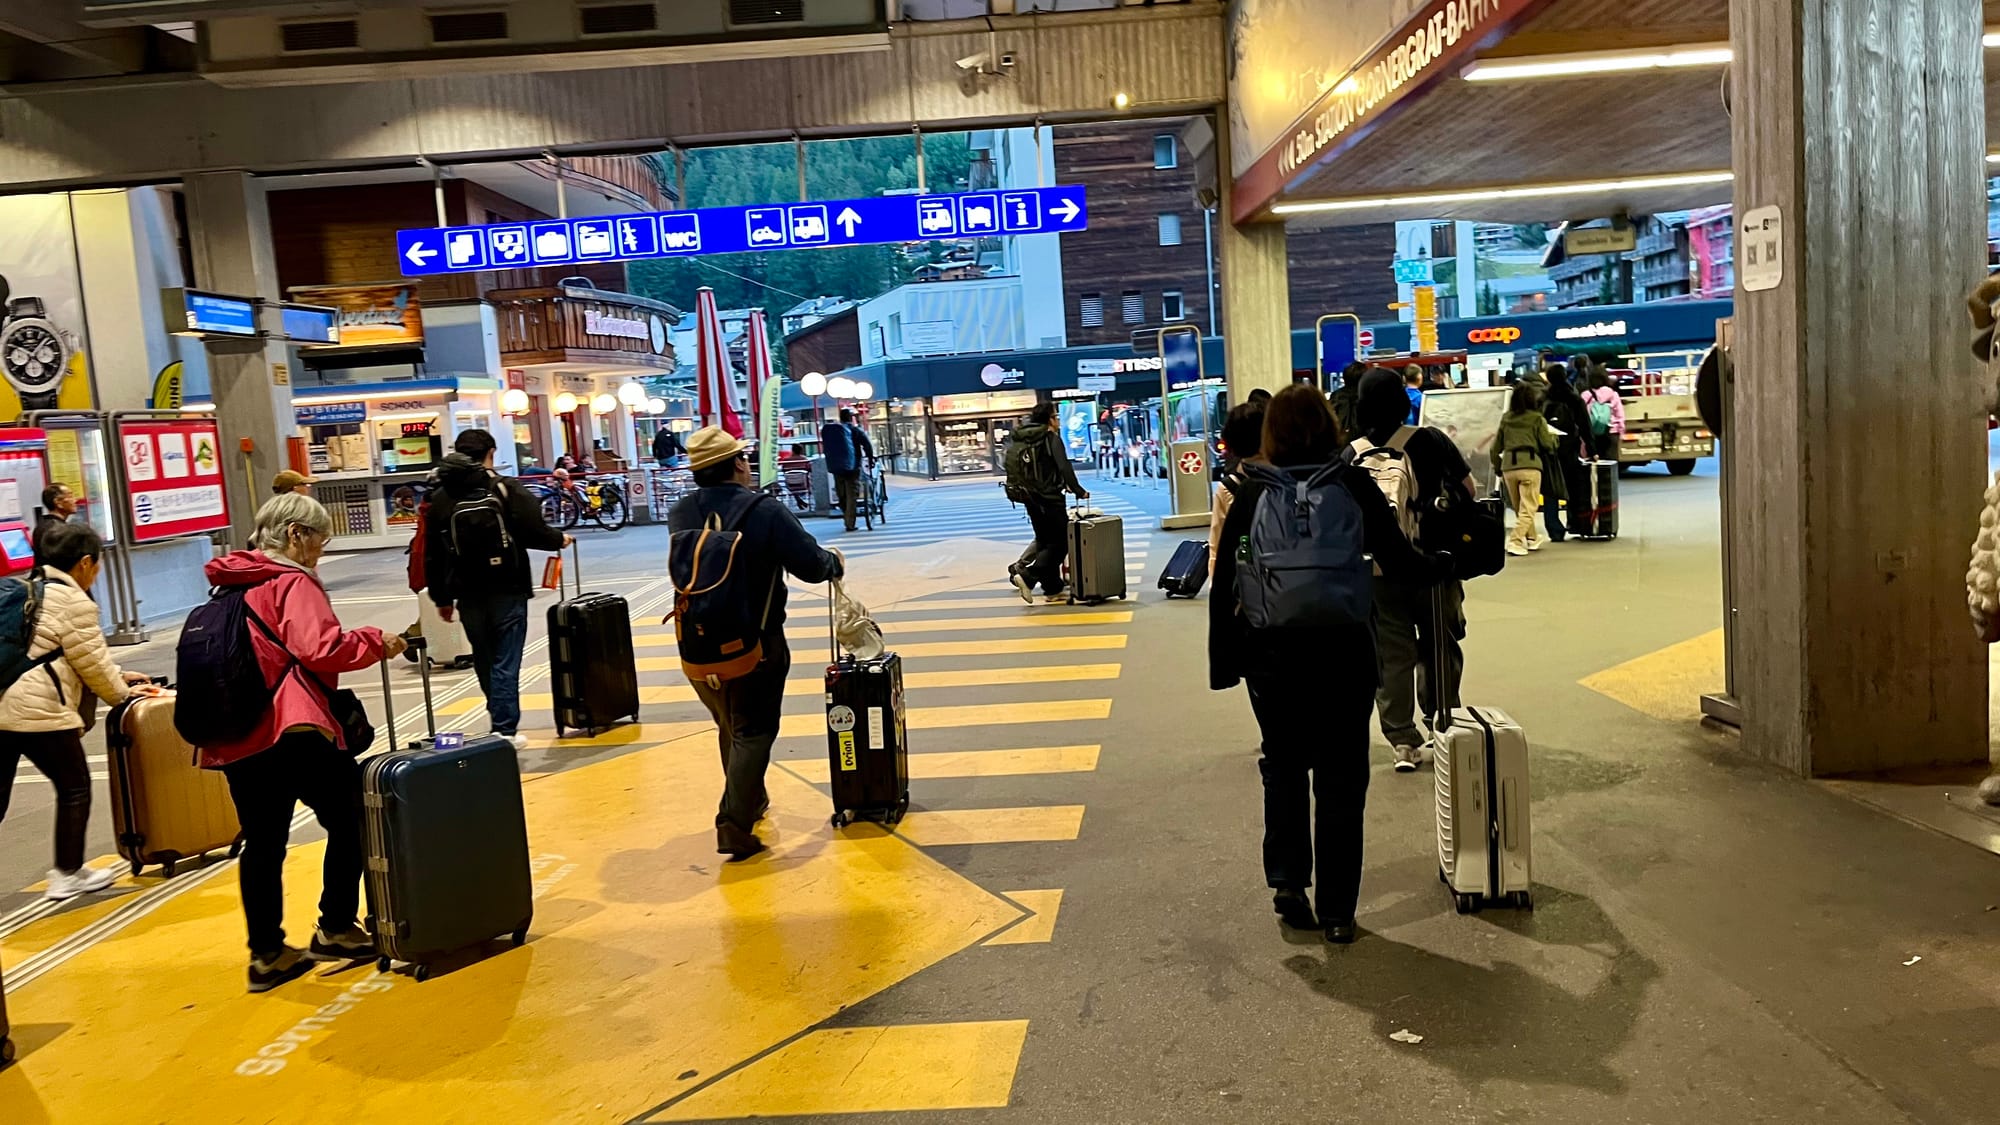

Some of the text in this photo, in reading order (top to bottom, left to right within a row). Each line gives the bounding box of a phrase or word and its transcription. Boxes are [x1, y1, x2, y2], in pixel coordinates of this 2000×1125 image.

[665, 231, 697, 247] WC
[1467, 327, 1521, 344] coop
[380, 400, 426, 412] SCHOOL
